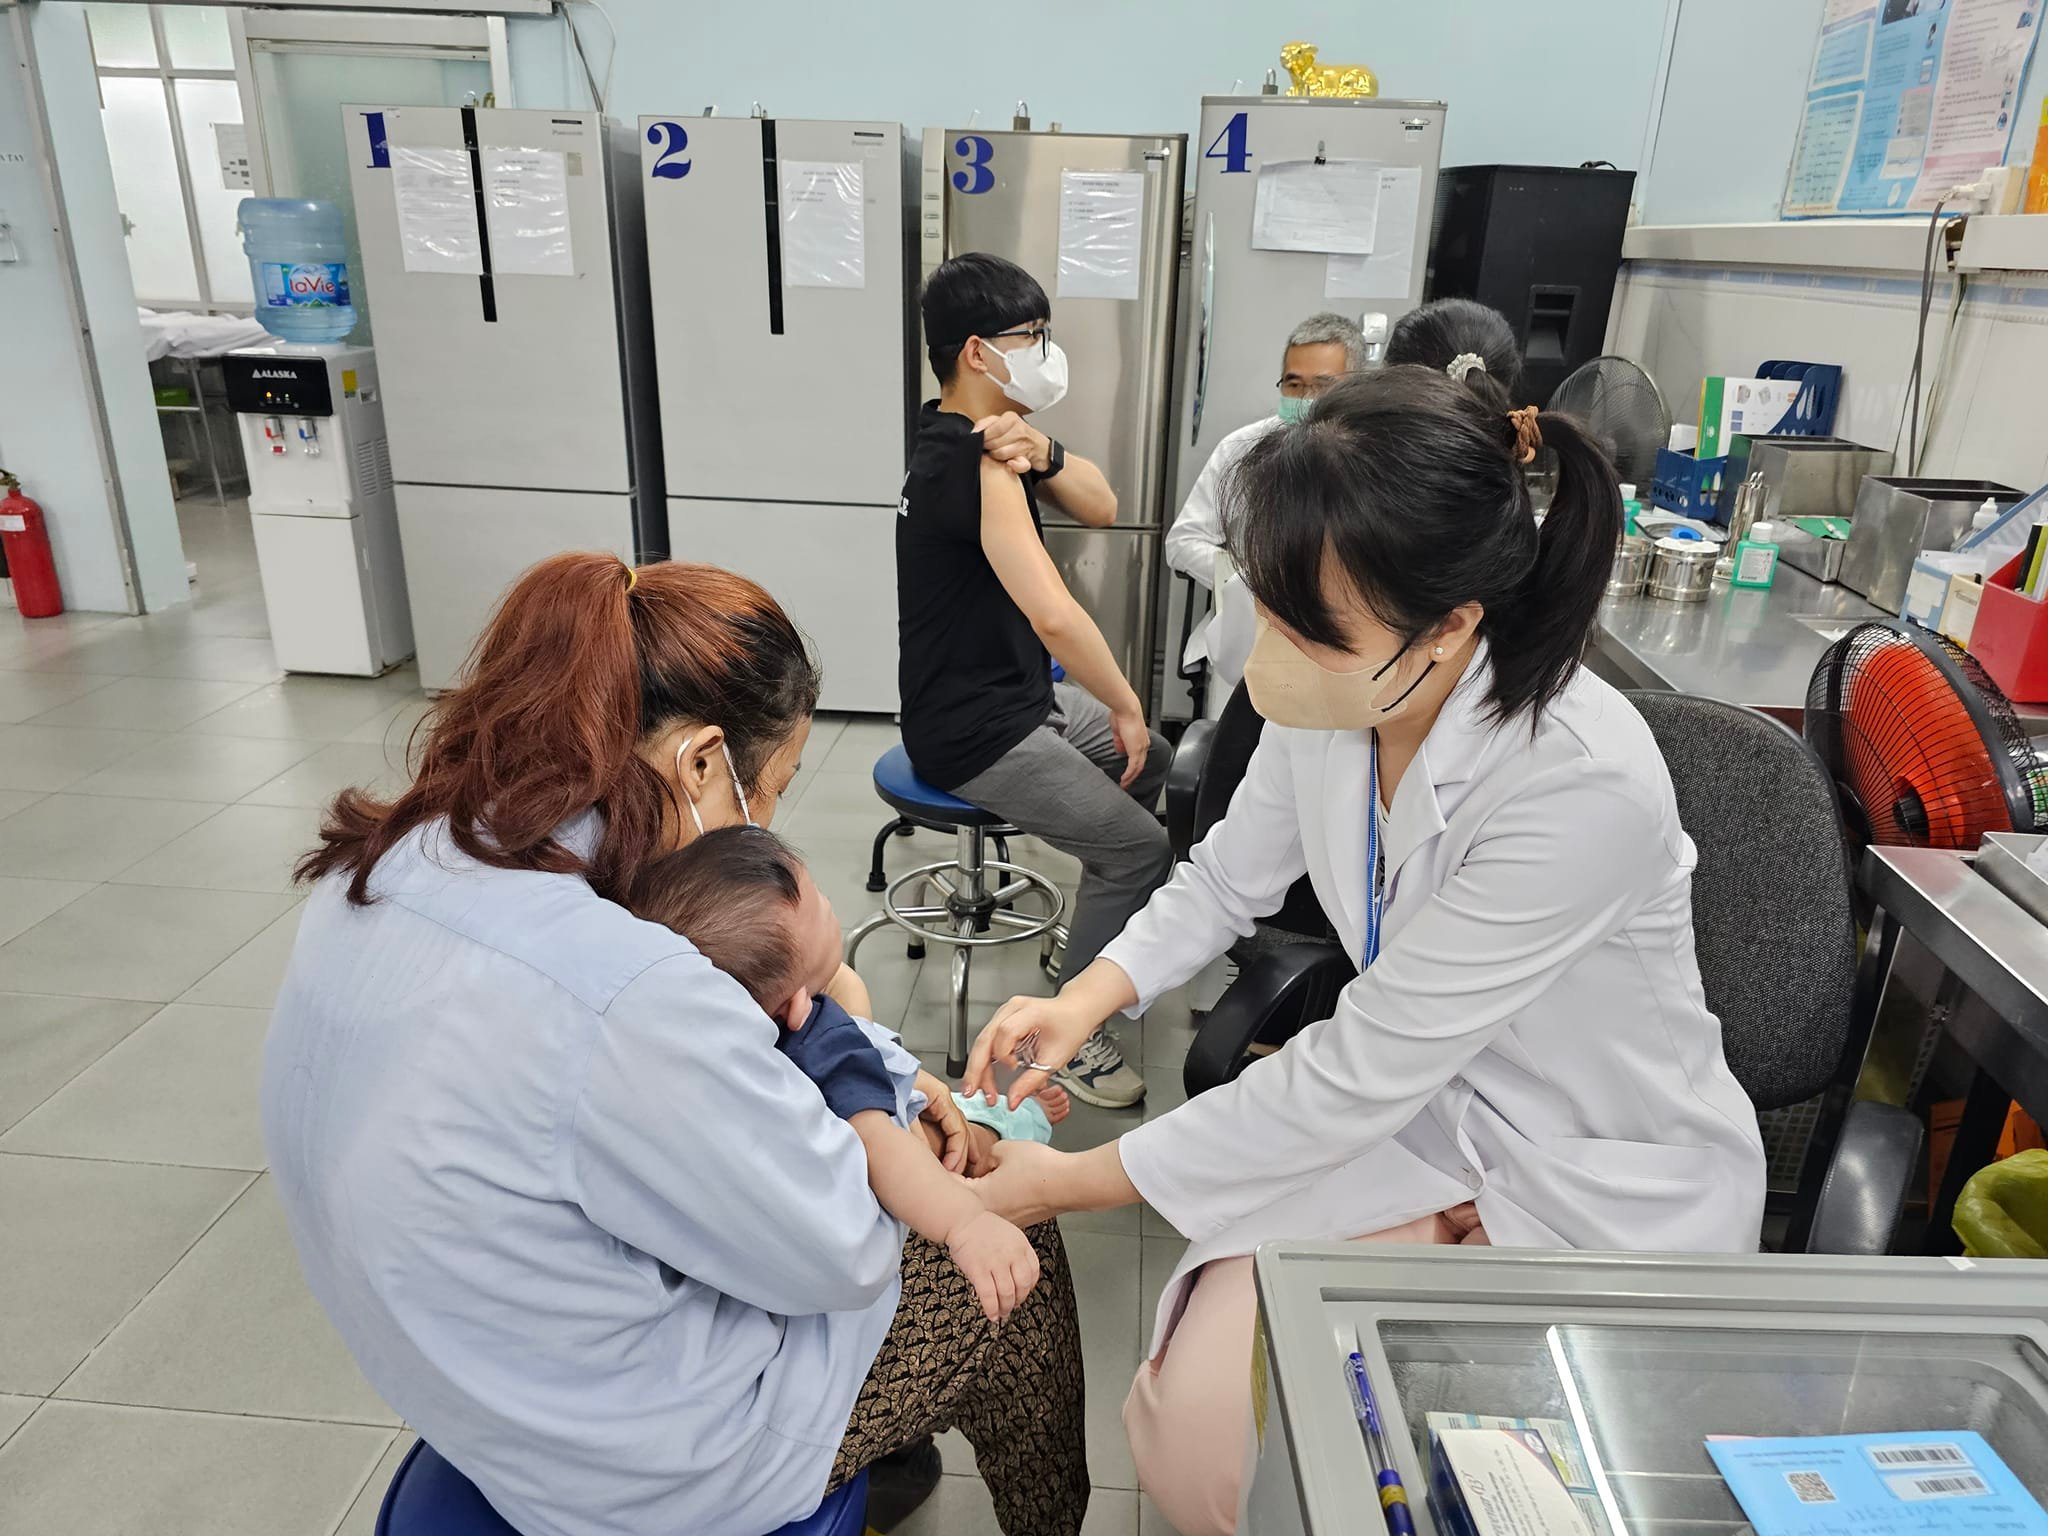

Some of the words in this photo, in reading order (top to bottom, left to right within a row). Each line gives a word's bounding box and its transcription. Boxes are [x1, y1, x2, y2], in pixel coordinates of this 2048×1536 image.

[359, 111, 391, 168] 1
[647, 121, 692, 180] 2
[952, 135, 995, 195] 3
[1205, 112, 1253, 174] 4
[261, 369, 298, 380] ALASKA
